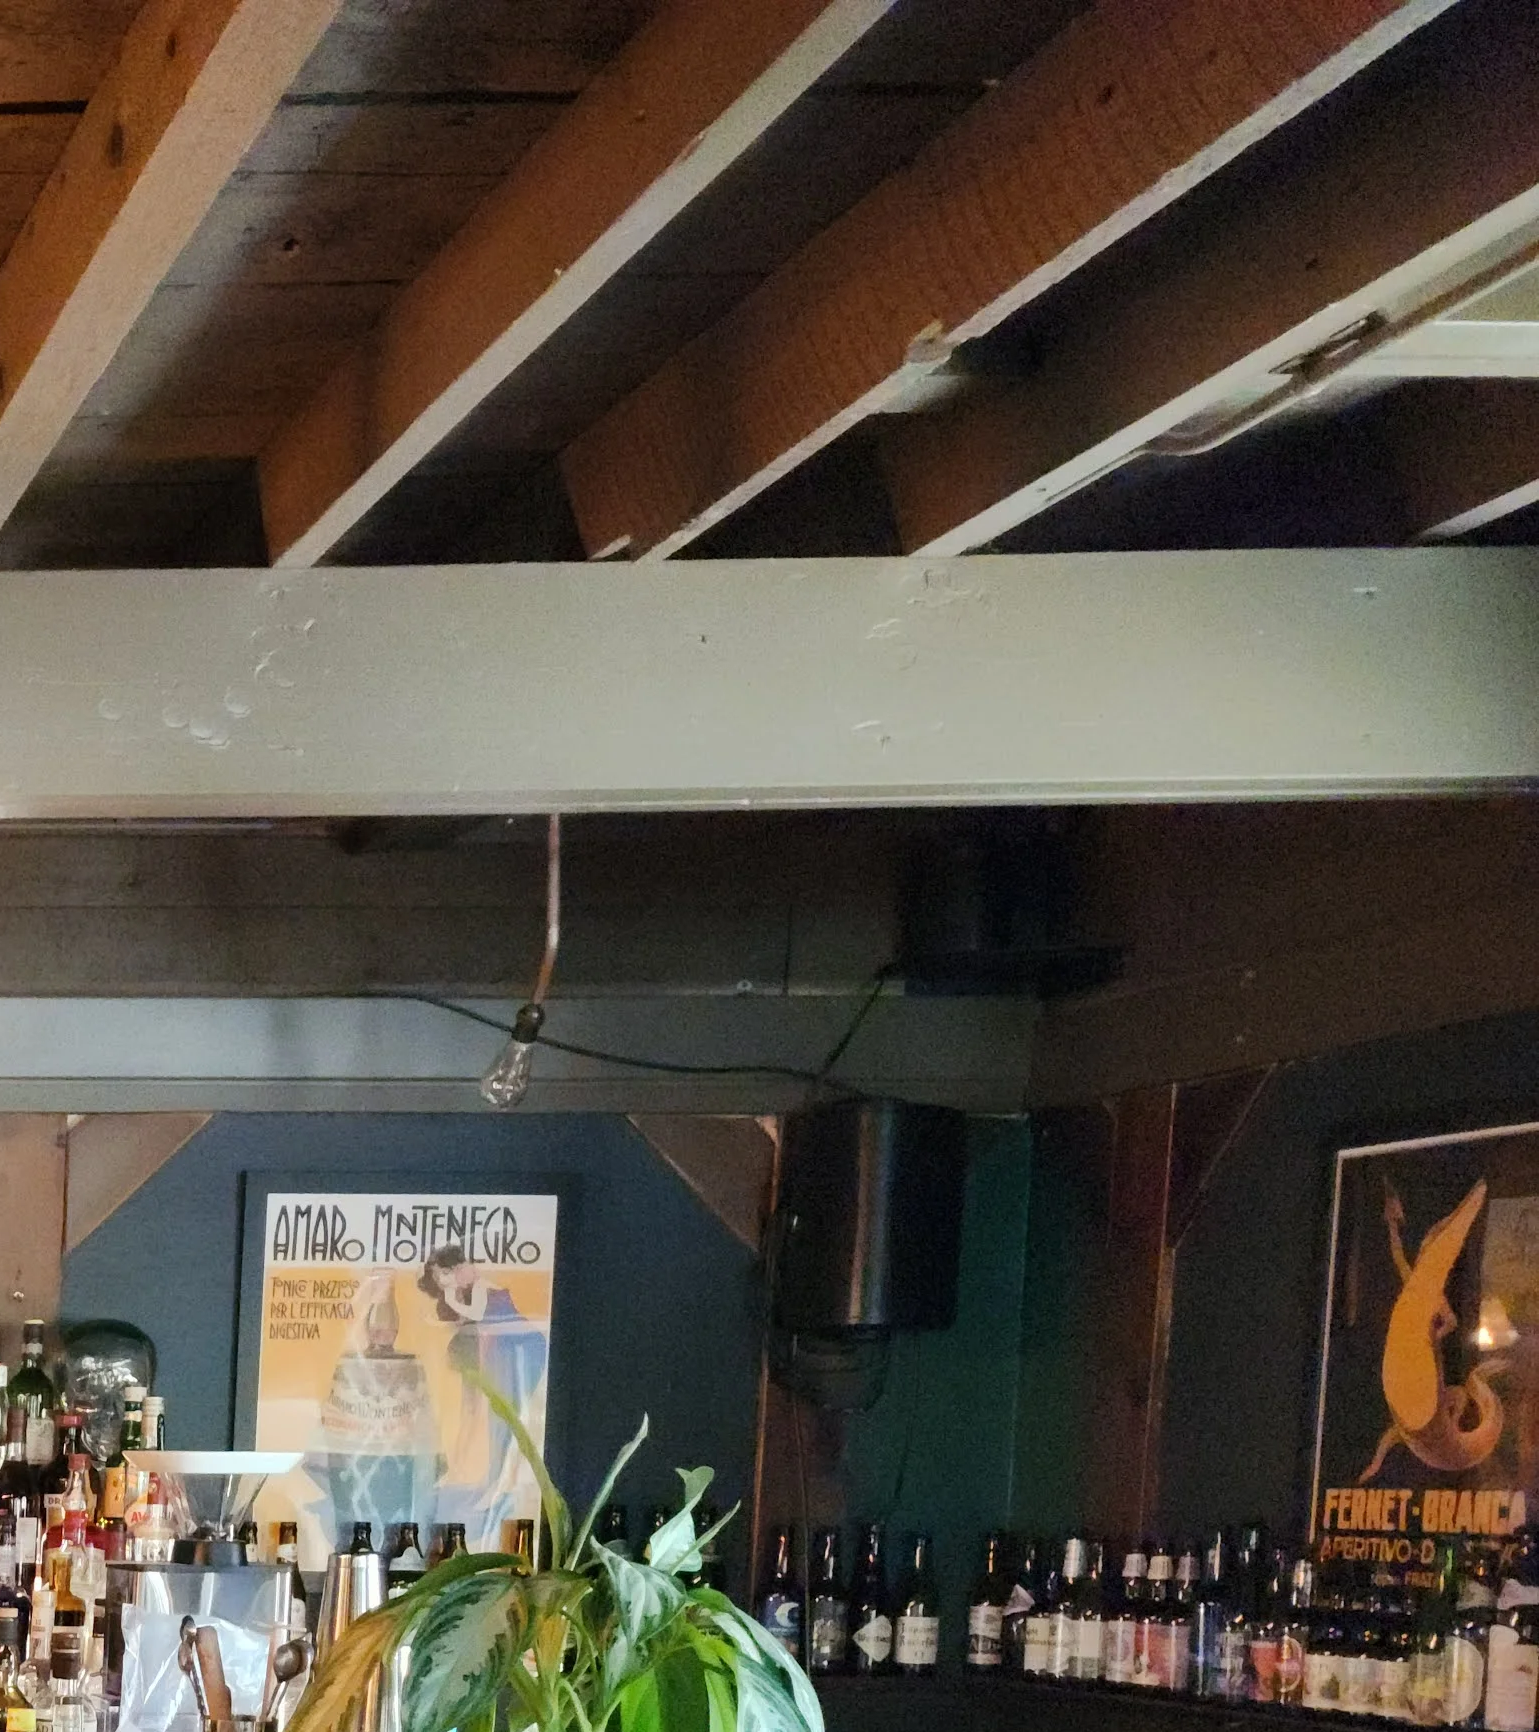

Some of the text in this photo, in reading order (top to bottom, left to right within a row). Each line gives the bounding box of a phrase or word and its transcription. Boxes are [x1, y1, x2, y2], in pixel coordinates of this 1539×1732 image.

[273, 1204, 541, 1265] AMARO MONTENEGRO
[269, 1322, 321, 1340] DIGESTIVA
